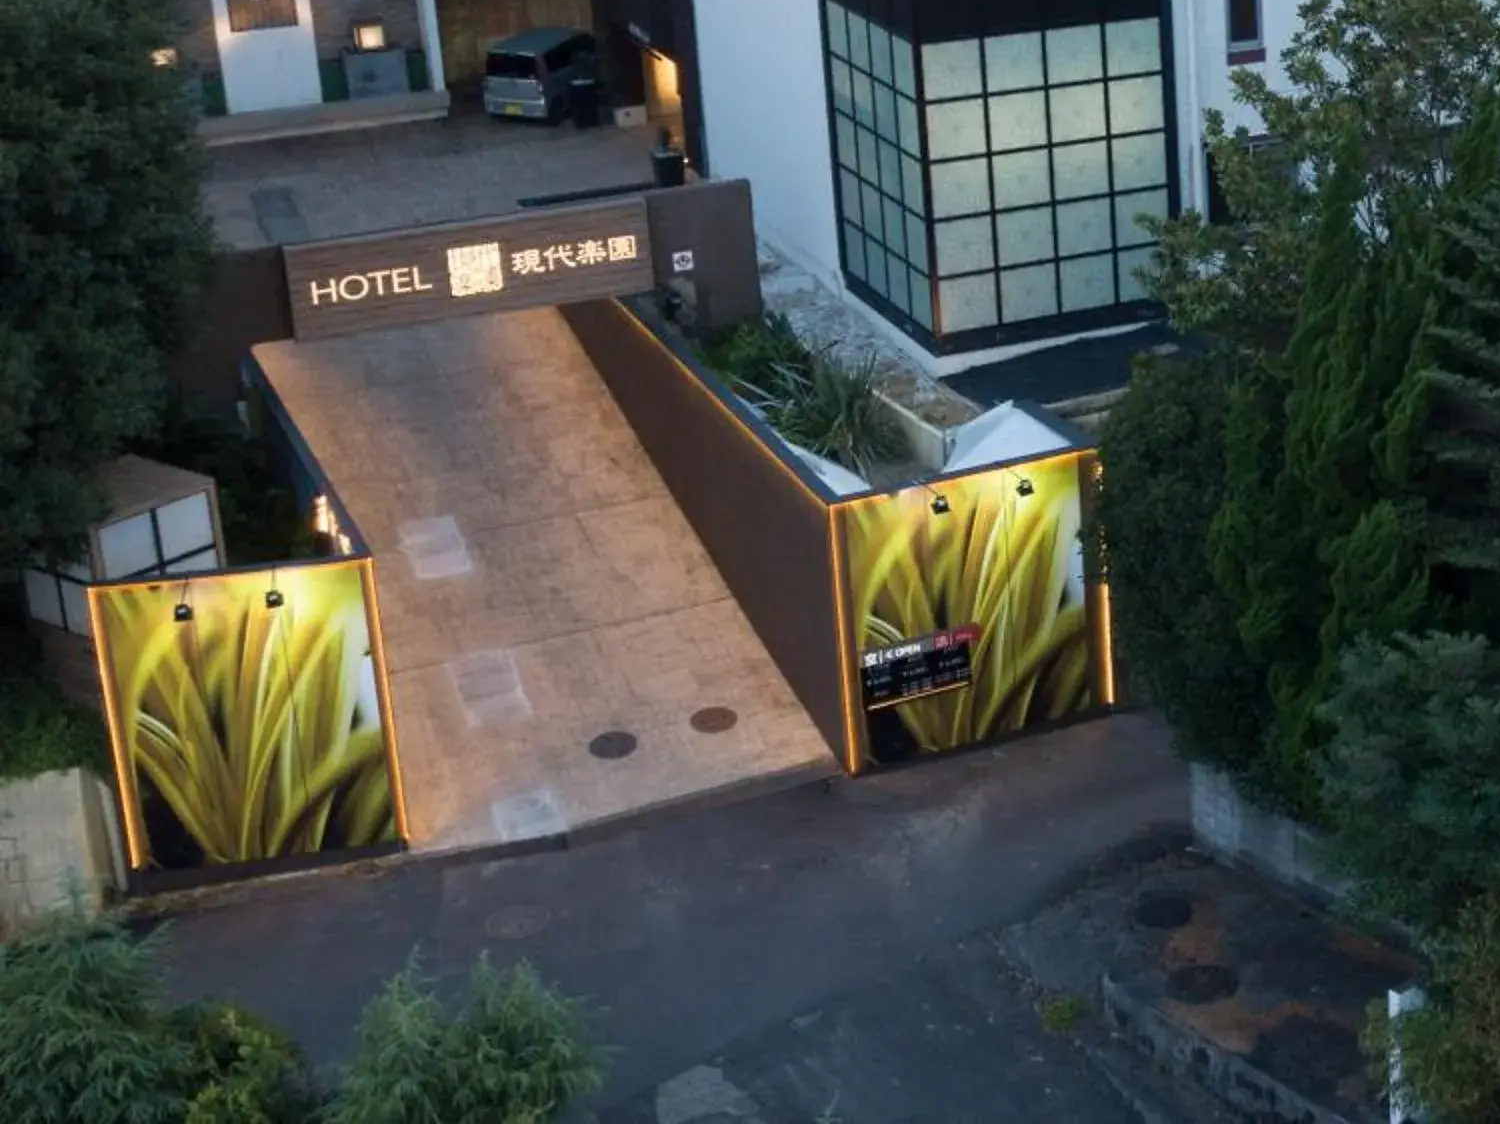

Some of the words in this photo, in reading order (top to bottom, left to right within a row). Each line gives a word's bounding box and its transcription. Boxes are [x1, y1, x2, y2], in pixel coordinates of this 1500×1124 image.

[511, 235, 637, 275] 現代楽園
[310, 265, 433, 305] HOTEL
